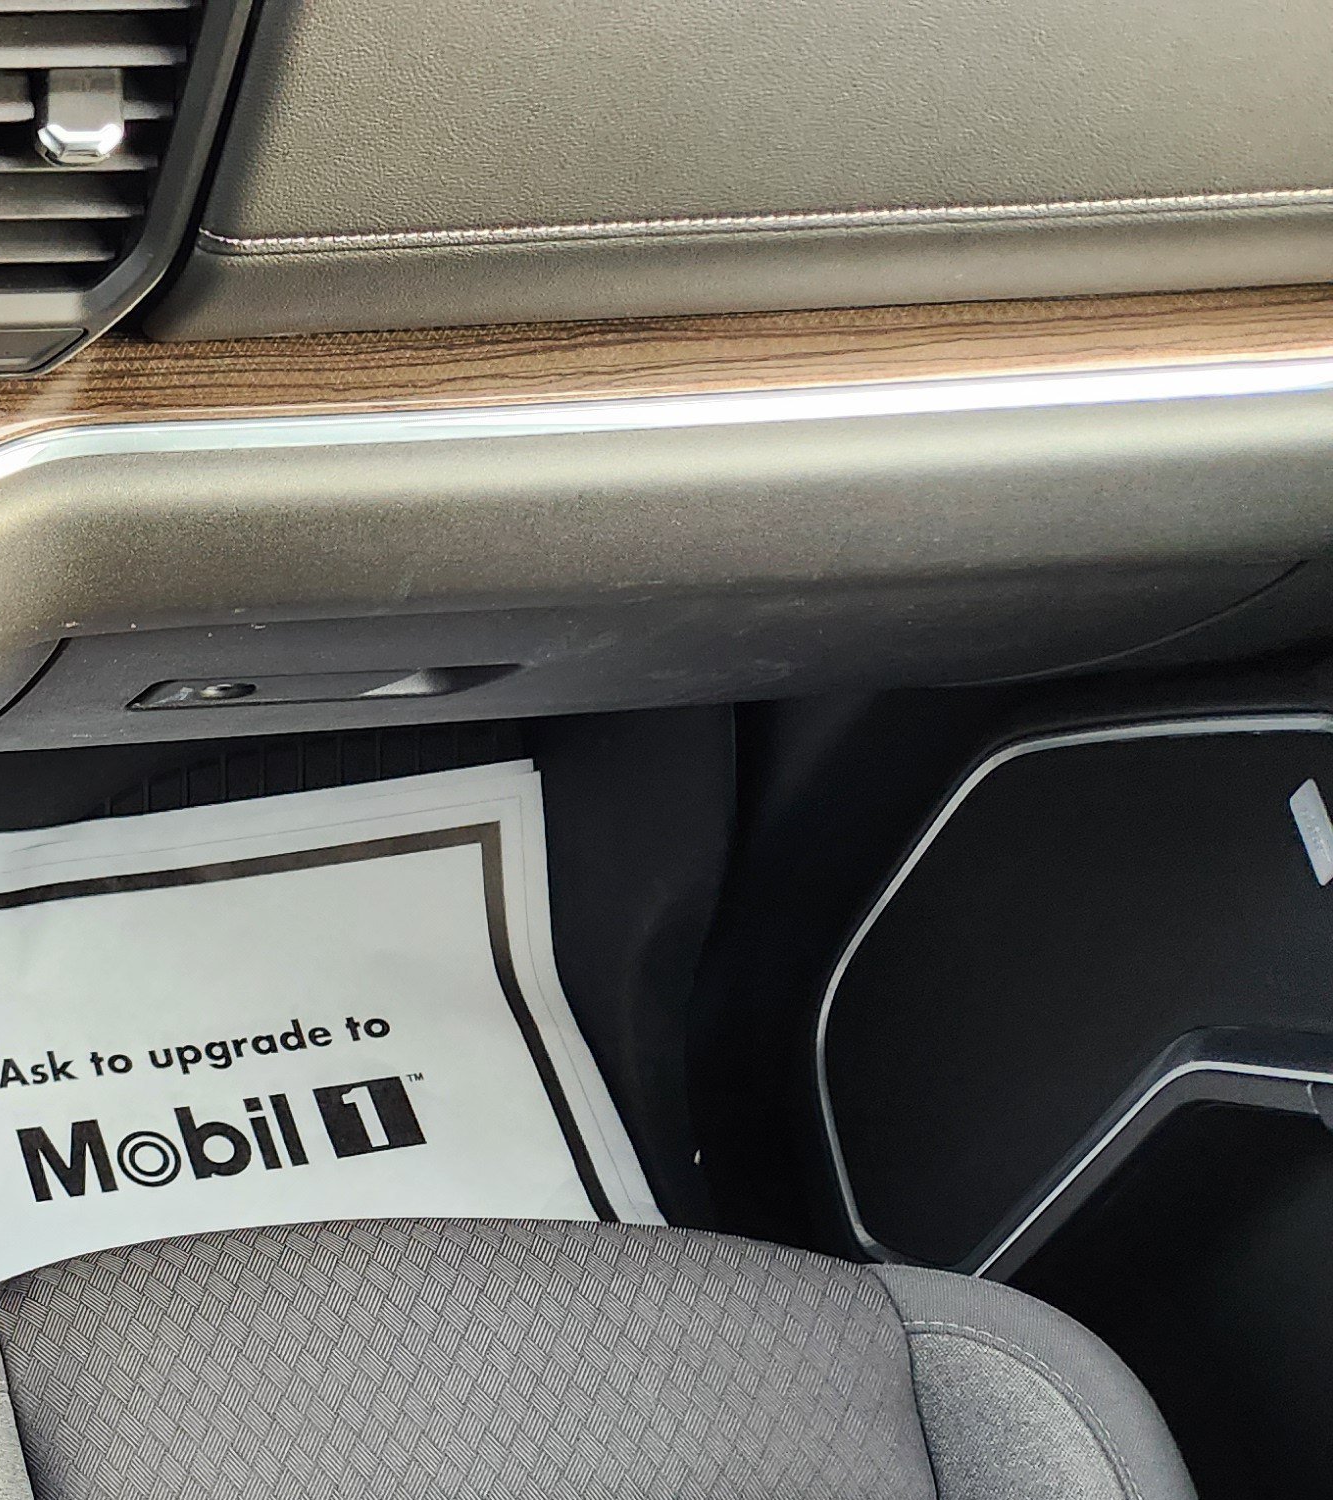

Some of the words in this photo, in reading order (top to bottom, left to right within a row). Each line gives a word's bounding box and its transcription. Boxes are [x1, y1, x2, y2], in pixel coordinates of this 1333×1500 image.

[90, 1051, 133, 1077] to
[148, 1018, 333, 1075] upgrade
[345, 1016, 391, 1041] to
[16, 1092, 310, 1203] Mobil
